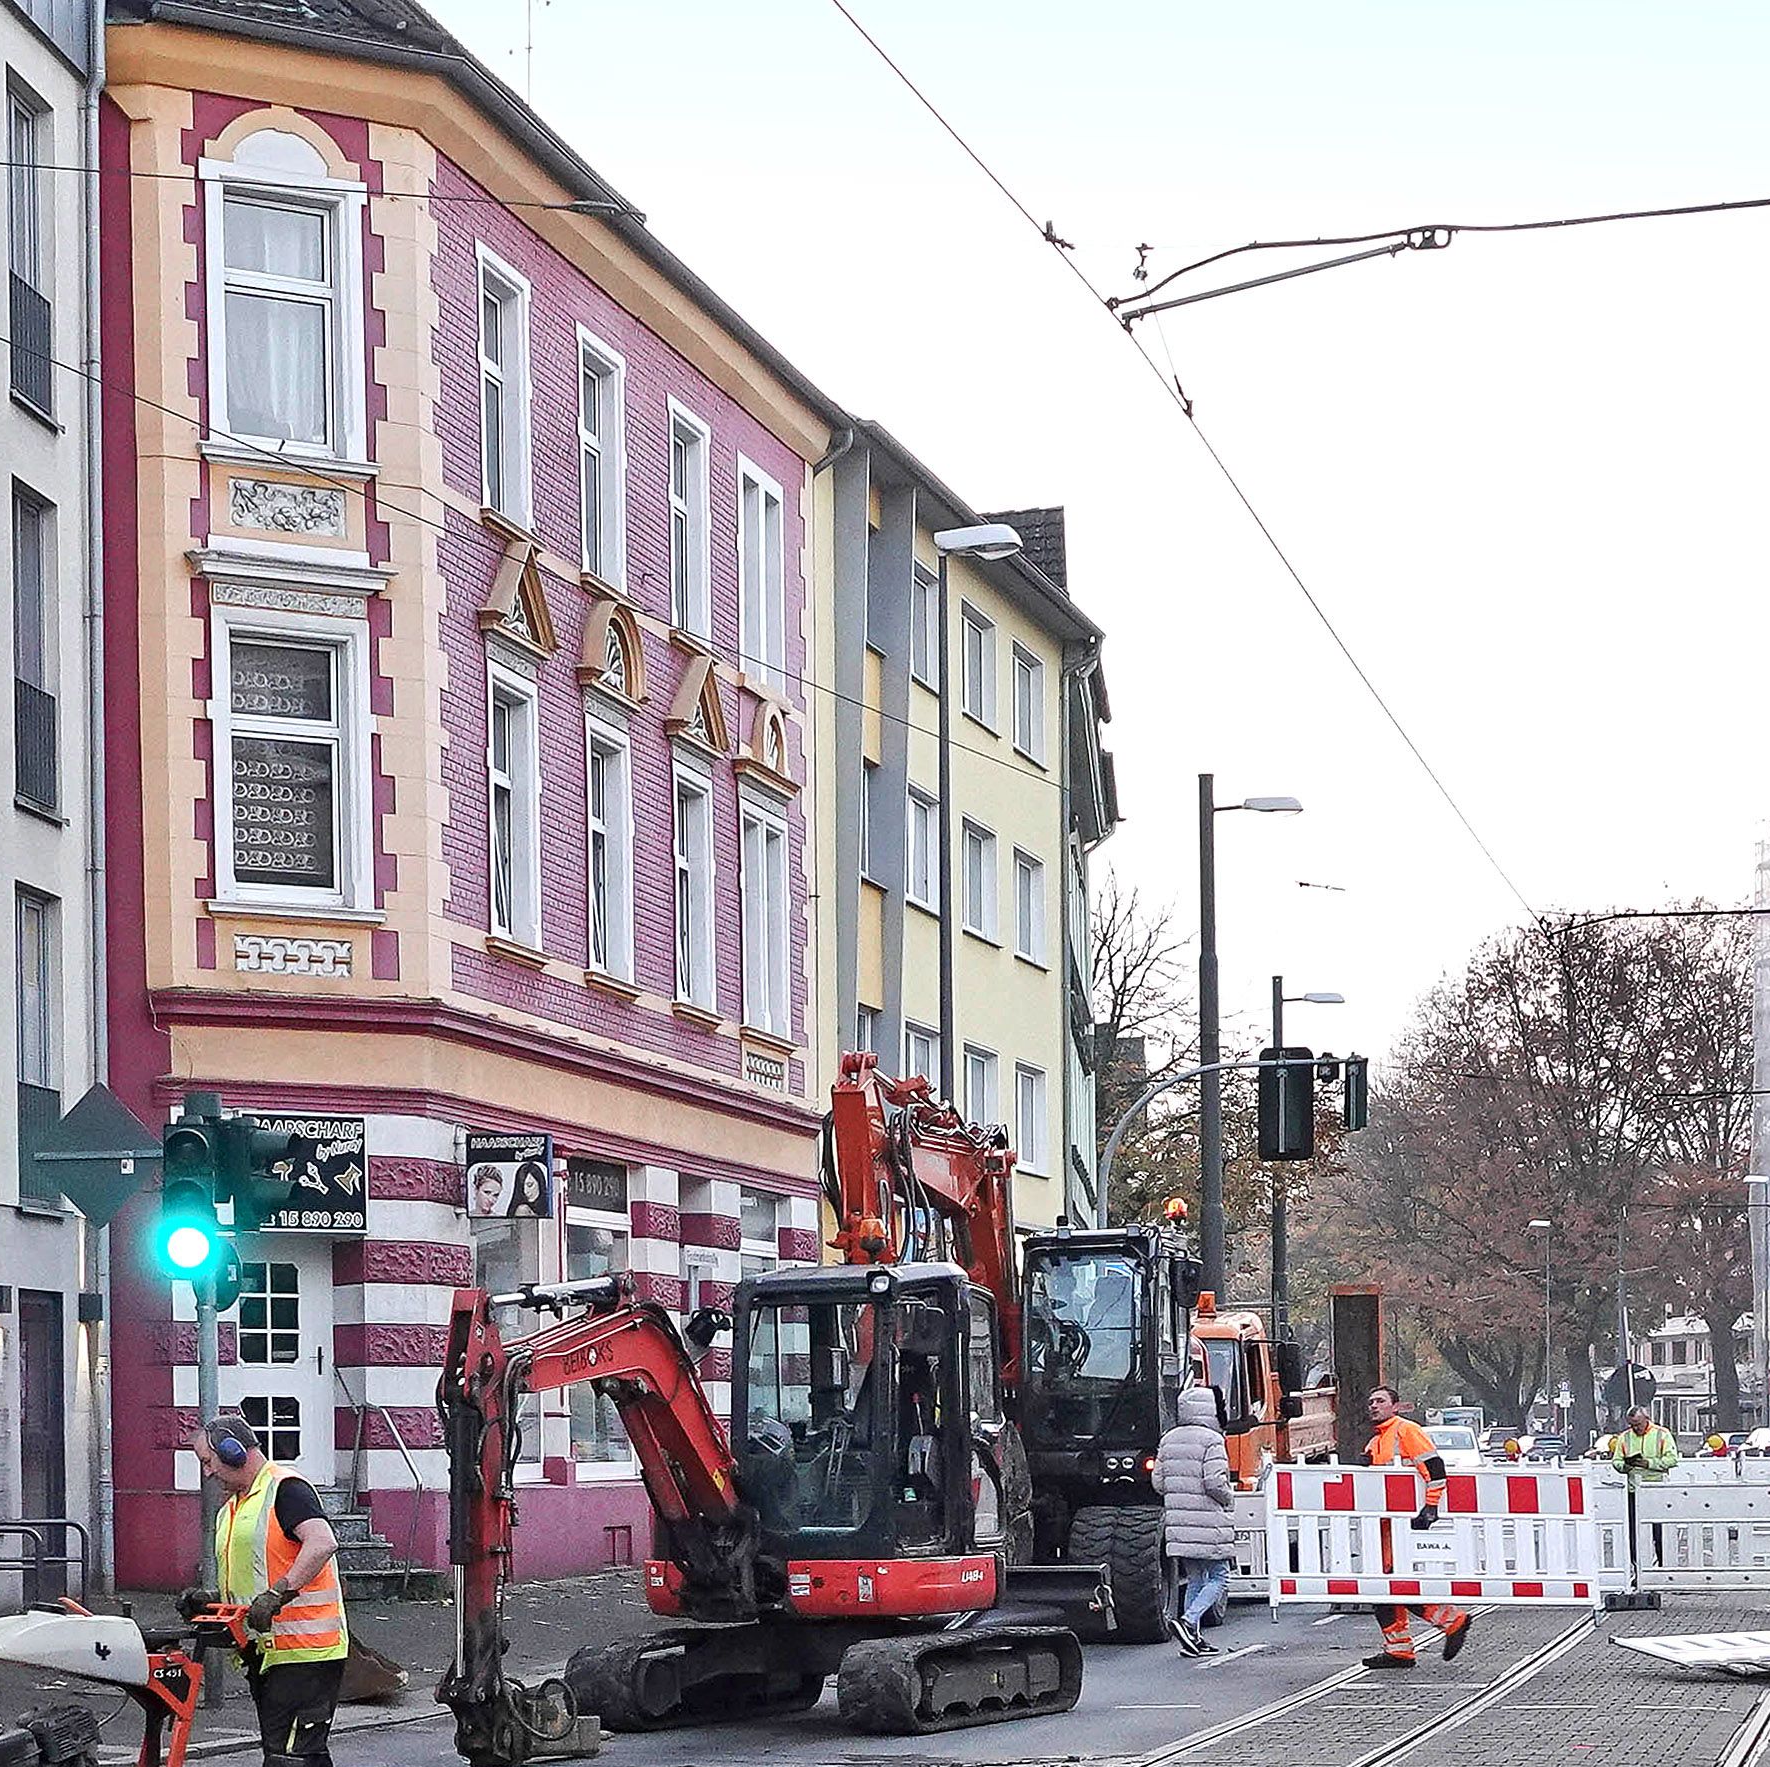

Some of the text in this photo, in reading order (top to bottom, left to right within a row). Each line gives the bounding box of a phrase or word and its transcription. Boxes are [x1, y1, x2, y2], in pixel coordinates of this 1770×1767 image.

[254, 1117, 364, 1140] AARSCHARF
[316, 1143, 330, 1162] by
[574, 1171, 584, 1193] 15
[279, 1210, 299, 1226] 15
[301, 1212, 331, 1227] 890
[333, 1212, 363, 1228] 290
